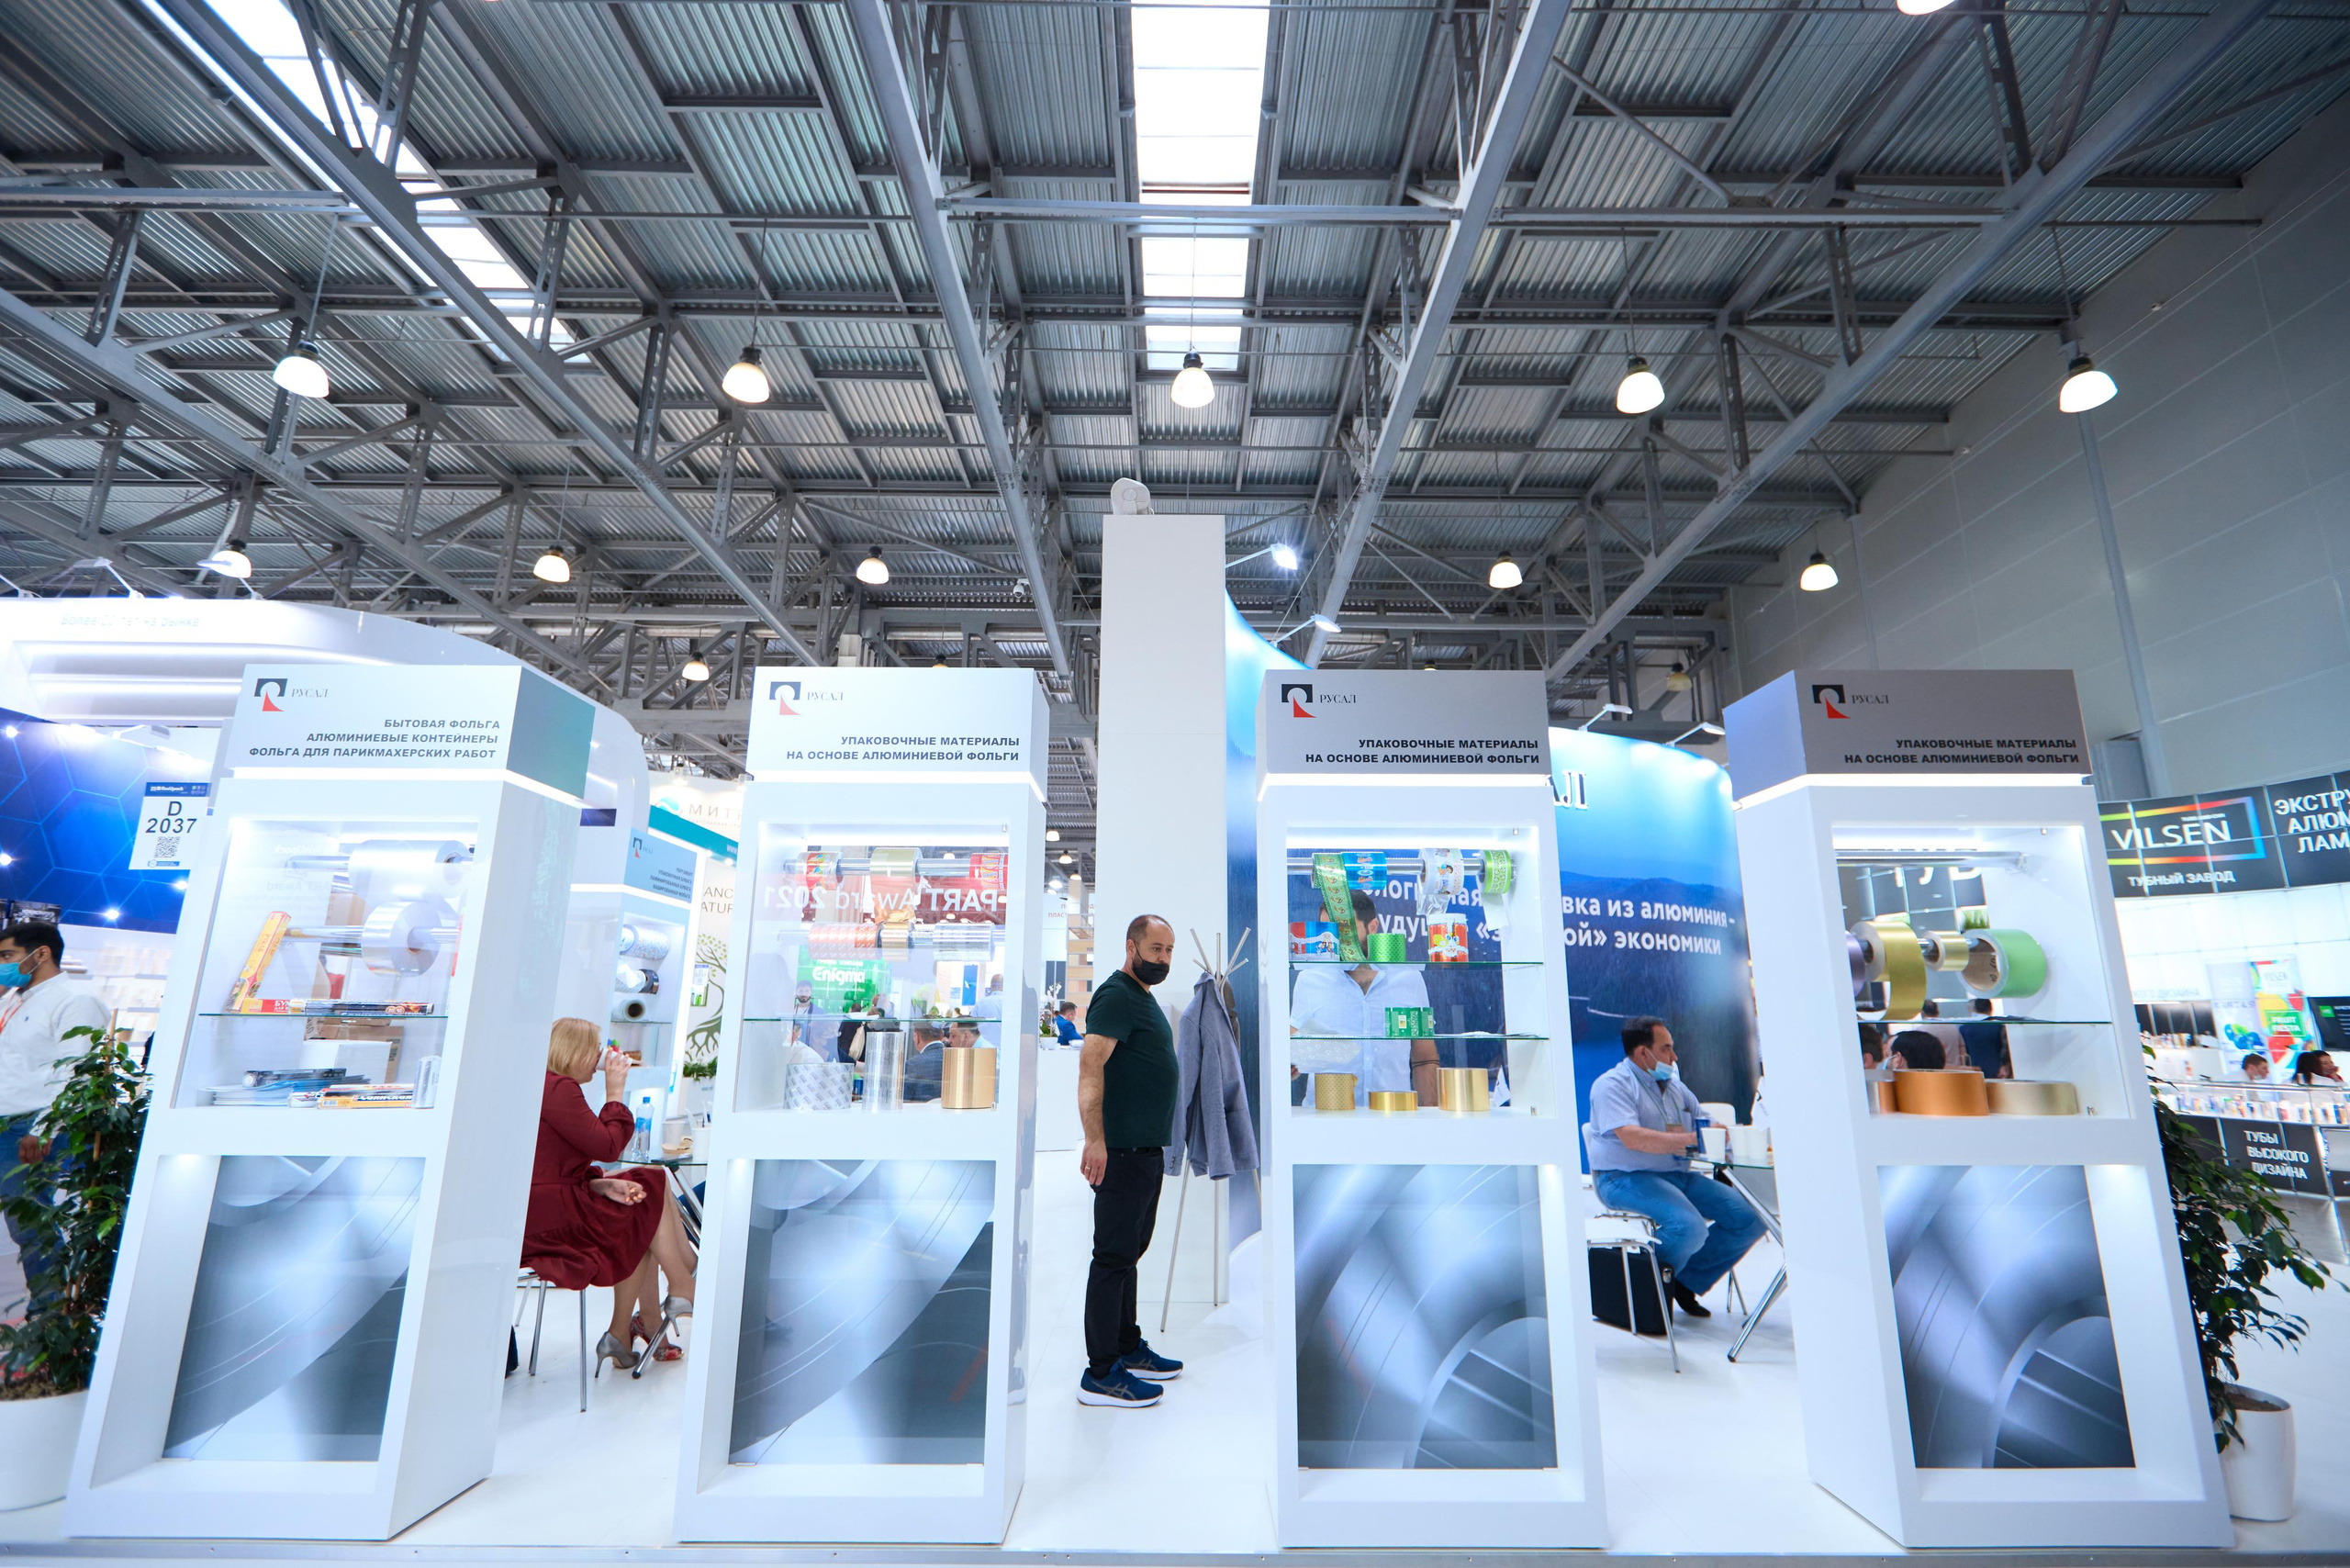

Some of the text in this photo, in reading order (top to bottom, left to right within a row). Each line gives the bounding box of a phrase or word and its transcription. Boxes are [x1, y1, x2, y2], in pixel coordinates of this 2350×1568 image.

[291, 688, 329, 699] РУСАЛ
[807, 691, 844, 702] РУСАЛ
[1319, 694, 1357, 704] РУСАЛ
[1852, 694, 1889, 704] РУСАЛ
[384, 719, 500, 730] БЫТОВАЯ ФОЛЬГА
[306, 733, 498, 745] АЛЮМИНИЕВЫЕ КОНТЕЙНЕРЫ
[841, 736, 1020, 746] УПАКОВОЧНЫЕ МАТЕРИАЛЫ
[1359, 739, 1539, 749] УПАКОВОЧНЫЕ МАТЕРИАЛЫ
[1896, 739, 2076, 748] УПАКОВОЧНЫЕ МАТЕРИАЛЫ
[249, 747, 497, 758] ФОЛЬГА ДЛЯ ПАРИКМАХЕРСКИХ РАБОТ
[786, 750, 1020, 761] НА ОСНОВЕ АЛЮМИНИЕВОЙ ФОЛЬГИ
[1304, 753, 1540, 764] НА ОСНОВЕ АЛЮМИНИЕВОЙ ФОЛЬГИ
[1844, 753, 2079, 764] НА ОСНОВЕ АЛЮМИНИЕВОЙ ФОЛЬГИ
[167, 801, 183, 816] D
[145, 818, 197, 834] 2037
[2111, 820, 2232, 850] VILSEN
[2127, 870, 2236, 887] ТУБНЫЙ ЗАВОД
[1607, 899, 1635, 918] из
[1640, 902, 1728, 927] алюминия
[1614, 930, 1722, 955] экономики
[811, 966, 866, 985] Enigma
[2244, 1130, 2279, 1145] ТУБЫ
[2246, 1146, 2310, 1164] ВЫСОКОГО
[2251, 1161, 2308, 1180] ДИЗАЙНА
